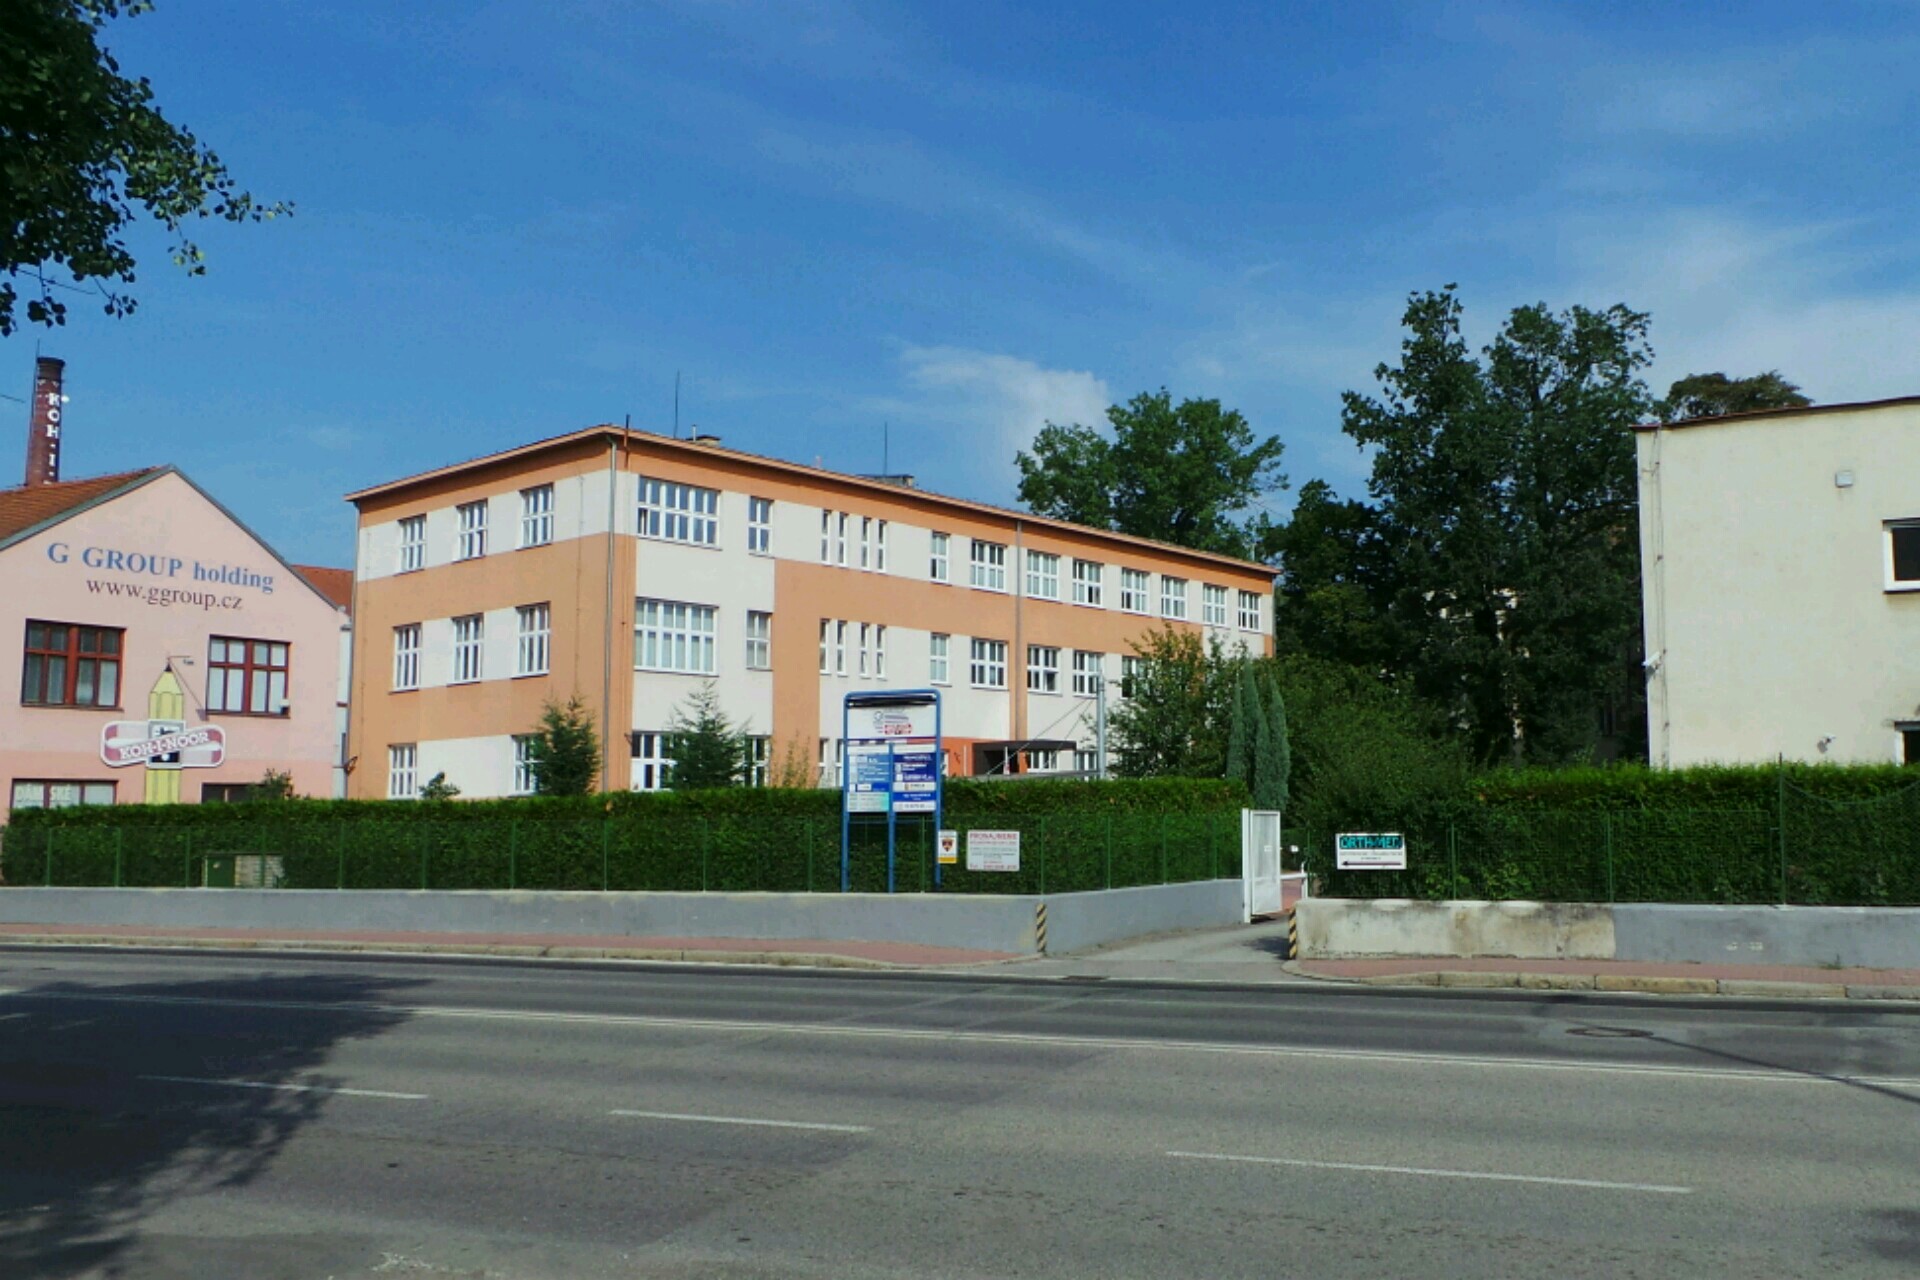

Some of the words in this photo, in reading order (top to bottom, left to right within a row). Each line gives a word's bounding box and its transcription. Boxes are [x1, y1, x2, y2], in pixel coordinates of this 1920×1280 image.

[46, 392, 60, 482] KOH-I-
[47, 542, 69, 564] G
[82, 546, 183, 577] GROUP
[192, 561, 274, 594] holding
[86, 579, 243, 611] www.ggroup.cz
